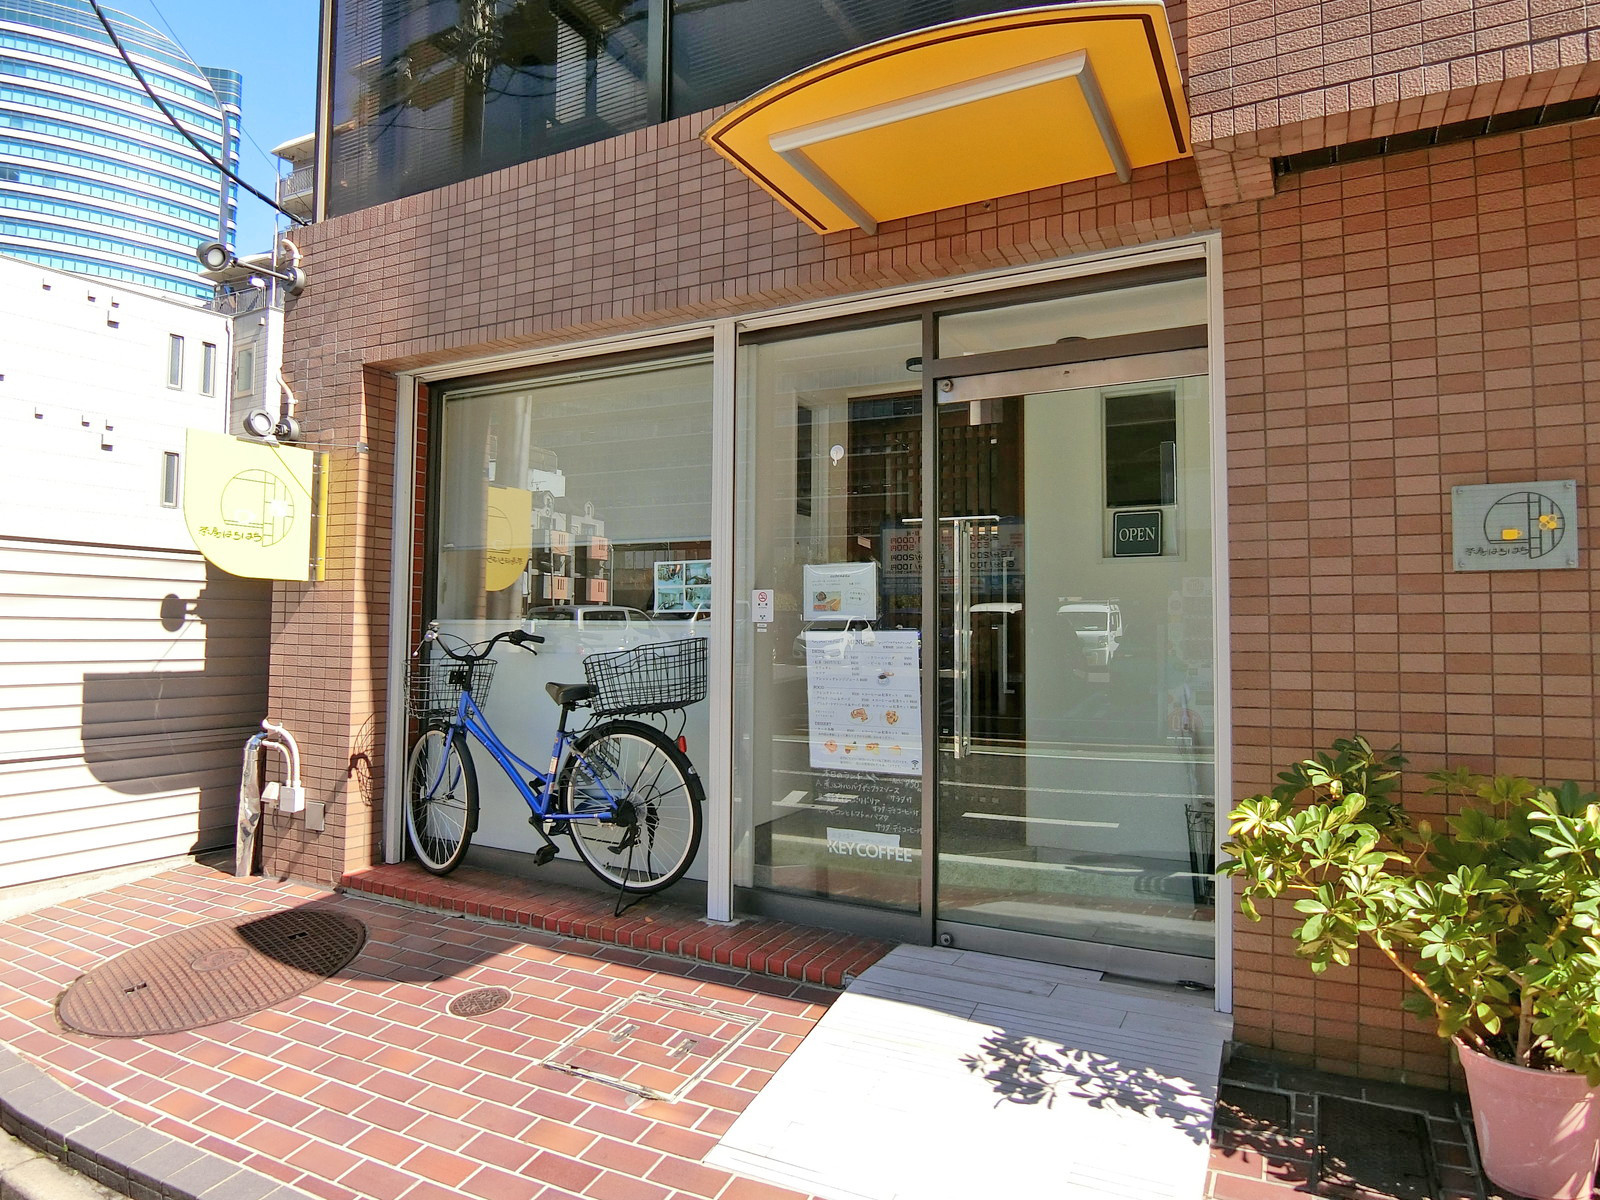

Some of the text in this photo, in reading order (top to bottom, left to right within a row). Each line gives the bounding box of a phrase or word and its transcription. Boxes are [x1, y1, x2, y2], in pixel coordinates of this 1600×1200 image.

[1119, 527, 1156, 542] OPEN
[827, 839, 856, 856] KEY
[856, 843, 913, 863] COFFEE
